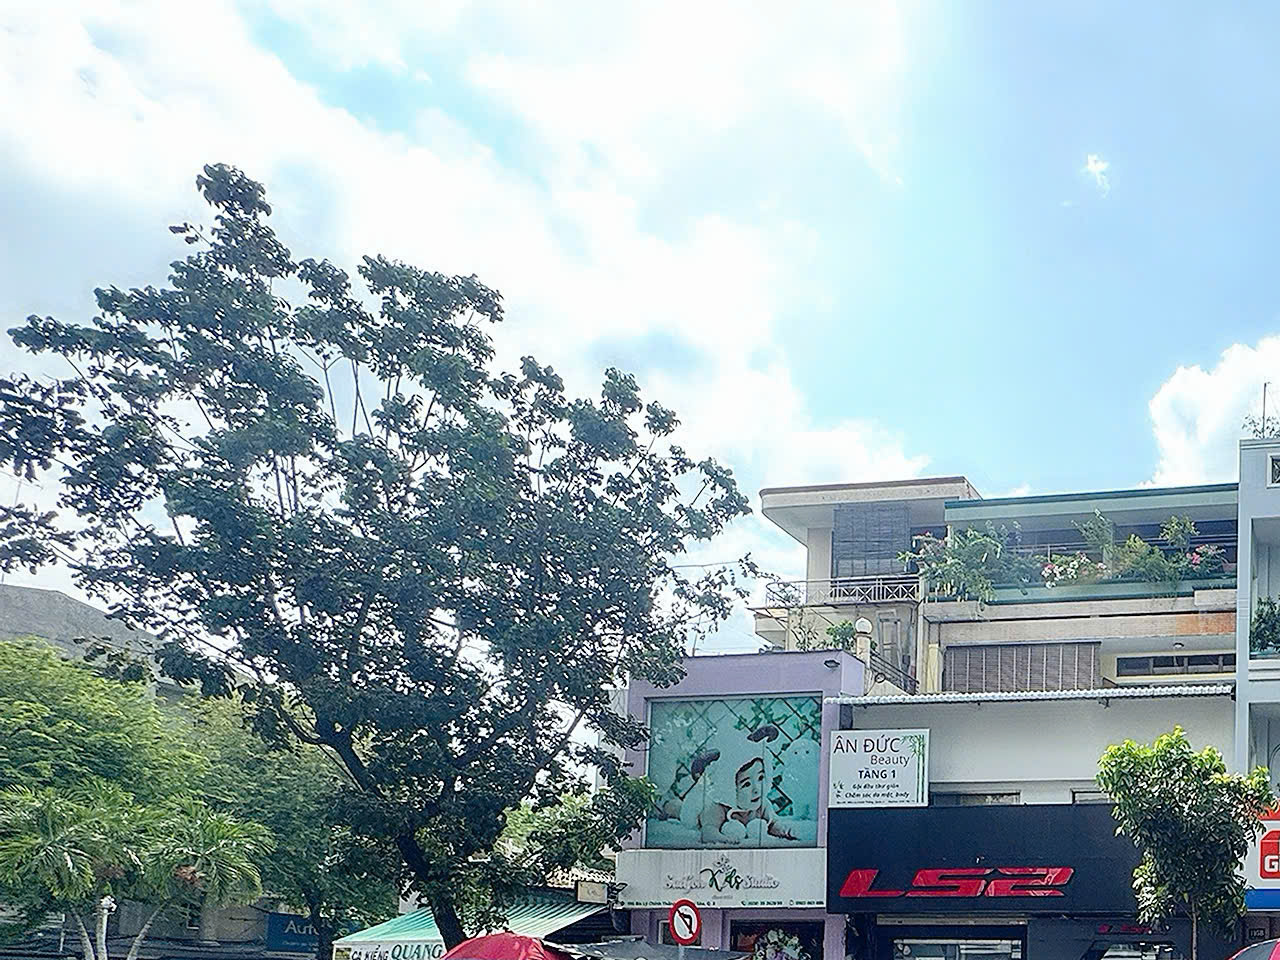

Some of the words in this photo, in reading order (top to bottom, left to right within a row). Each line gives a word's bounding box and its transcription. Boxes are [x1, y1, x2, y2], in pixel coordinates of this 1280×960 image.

[833, 735, 858, 754] ÂN
[863, 734, 901, 753] ĐỨC
[870, 754, 910, 767] Beauty
[891, 769, 896, 778] 1
[839, 868, 1074, 898] LS2
